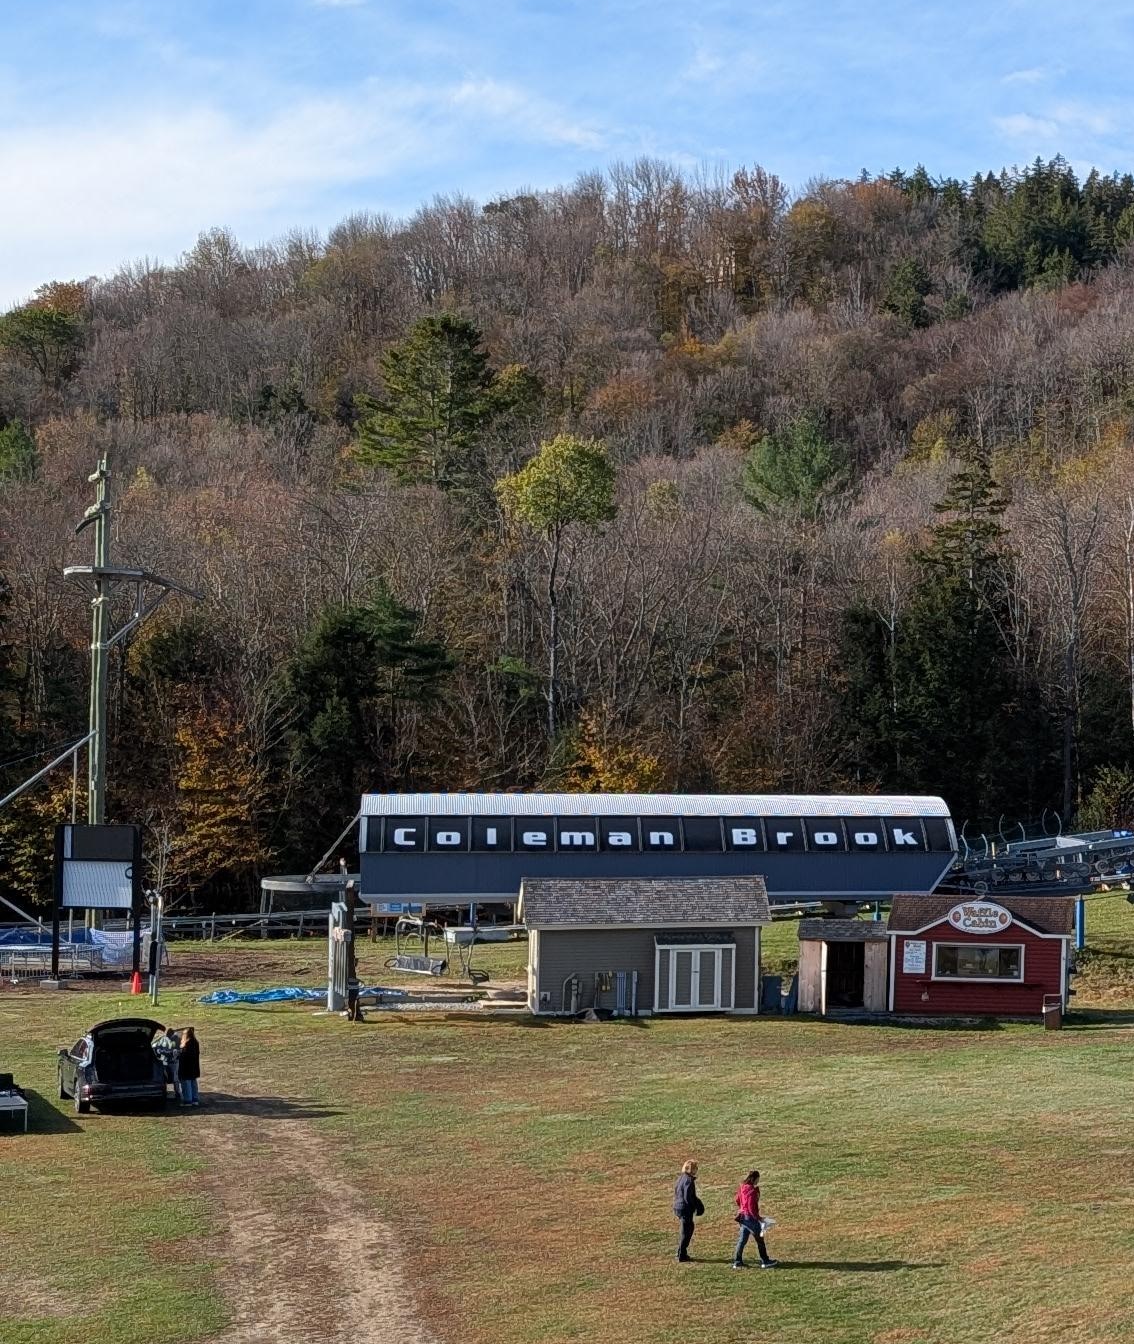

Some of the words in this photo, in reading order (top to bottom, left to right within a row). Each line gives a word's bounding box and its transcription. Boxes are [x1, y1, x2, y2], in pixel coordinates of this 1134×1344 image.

[393, 827, 674, 846] Coleman
[731, 828, 919, 845] Brook
[962, 906, 999, 917] Waffle
[962, 917, 998, 928] Cabin
